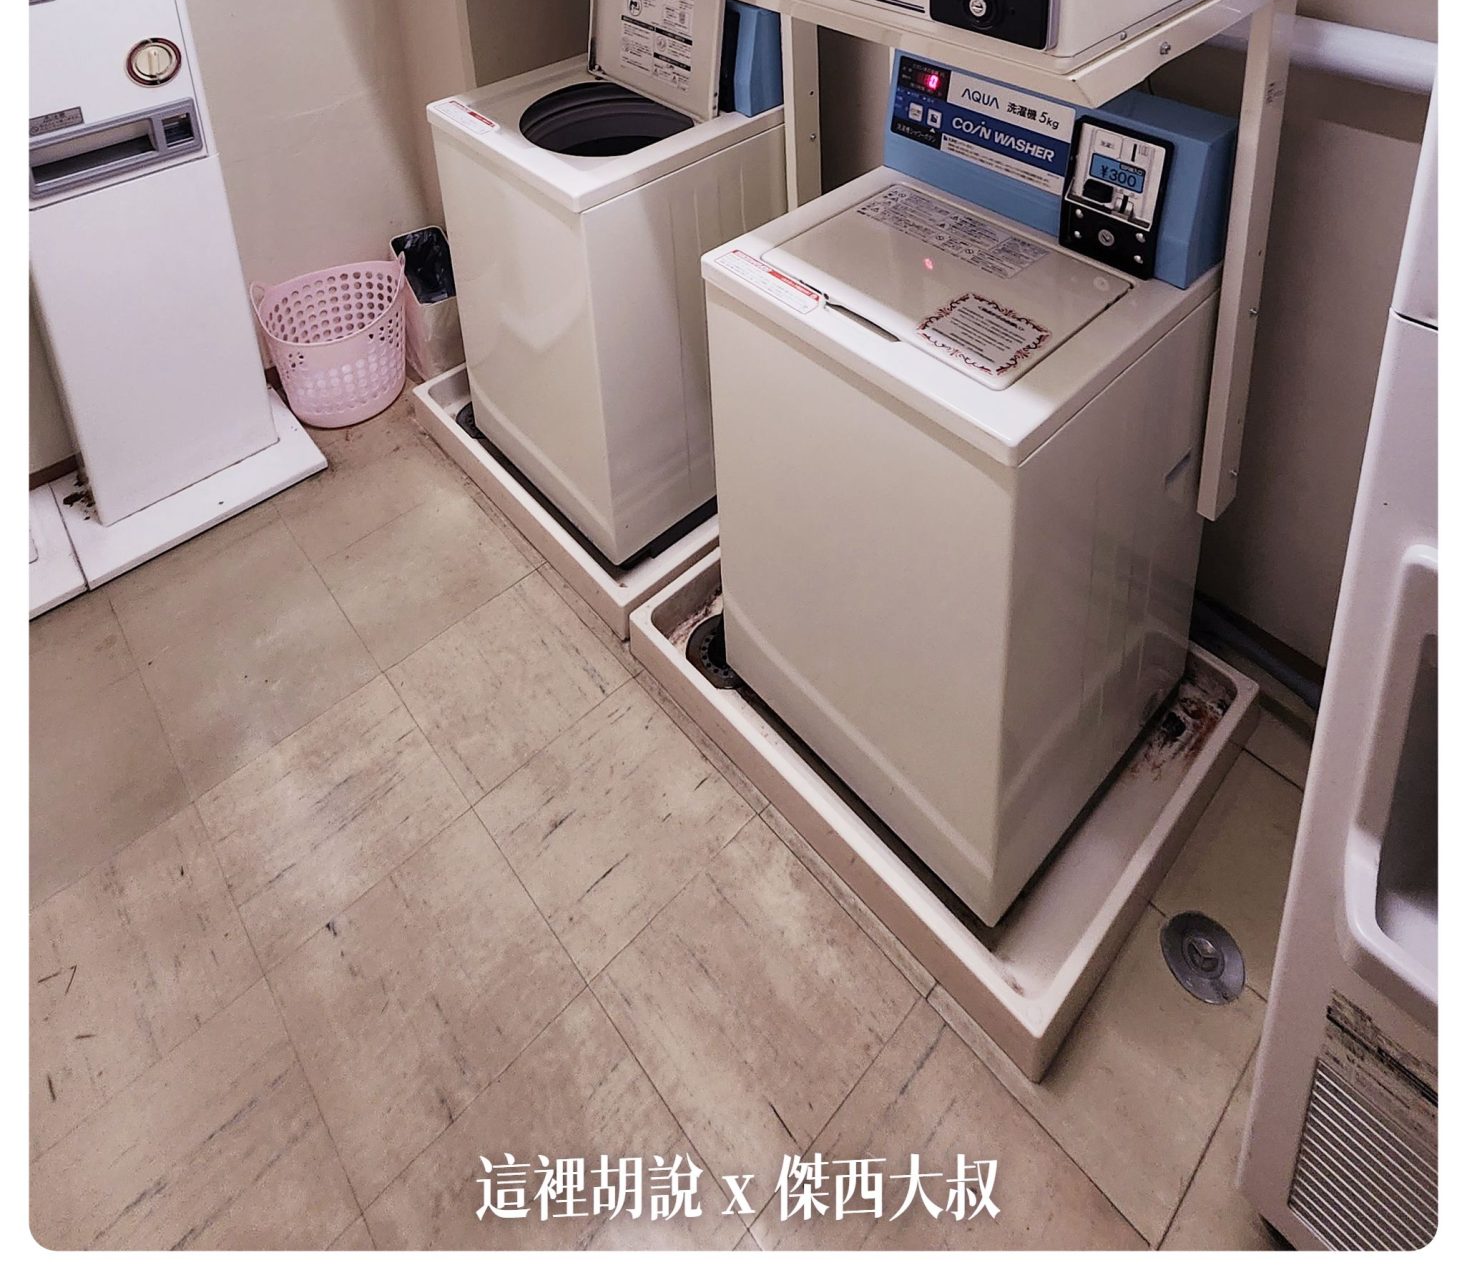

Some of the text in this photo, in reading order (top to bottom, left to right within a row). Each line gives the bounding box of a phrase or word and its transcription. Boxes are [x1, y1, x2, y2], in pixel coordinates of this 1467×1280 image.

[961, 88, 1000, 110] AQUA
[1006, 101, 1060, 130] 洗濯機 5kg
[952, 116, 991, 140] COIN
[994, 132, 1056, 162] WASHER
[1100, 164, 1137, 188] ¥300
